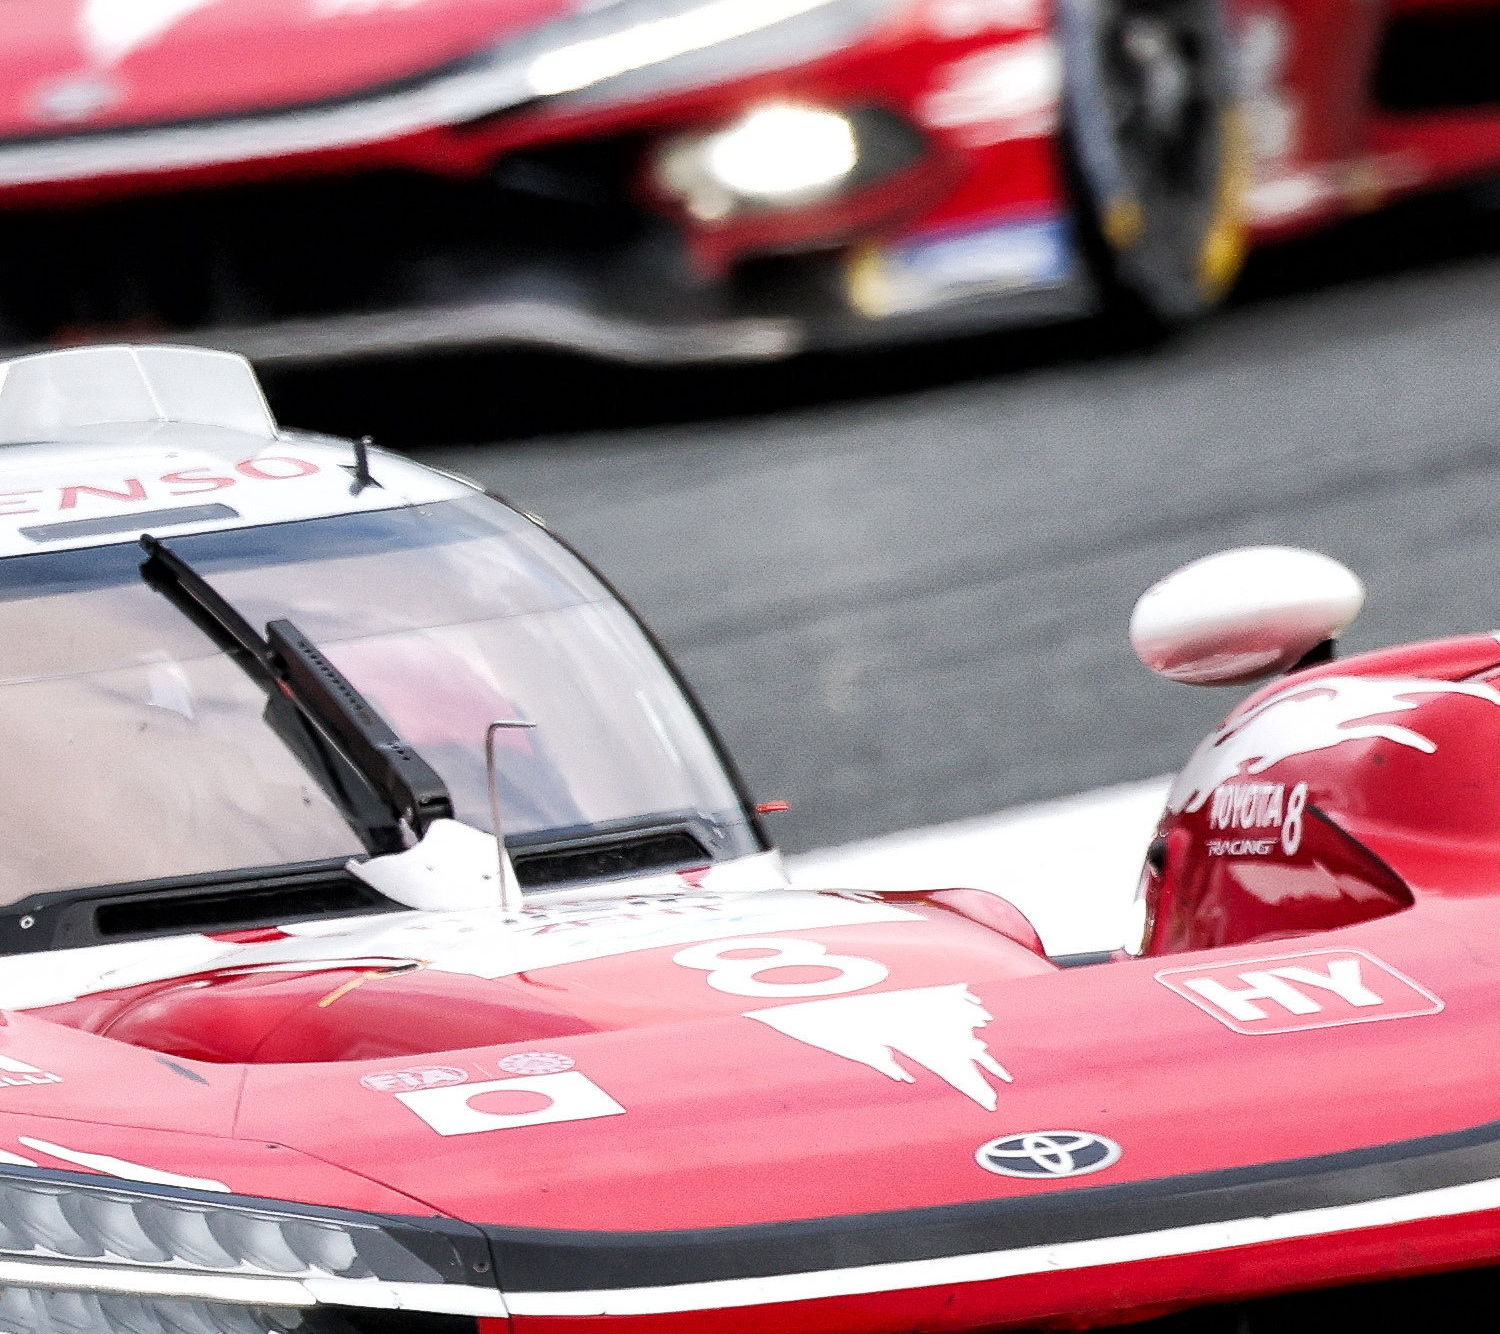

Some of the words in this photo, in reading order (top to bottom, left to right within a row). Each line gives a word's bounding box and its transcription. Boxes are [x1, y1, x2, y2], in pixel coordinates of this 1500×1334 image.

[1210, 783, 1286, 829] TOYOTA
[1281, 780, 1309, 857] 8
[1205, 838, 1279, 857] RACING
[672, 936, 889, 998] 8
[1186, 958, 1386, 1022] HY
